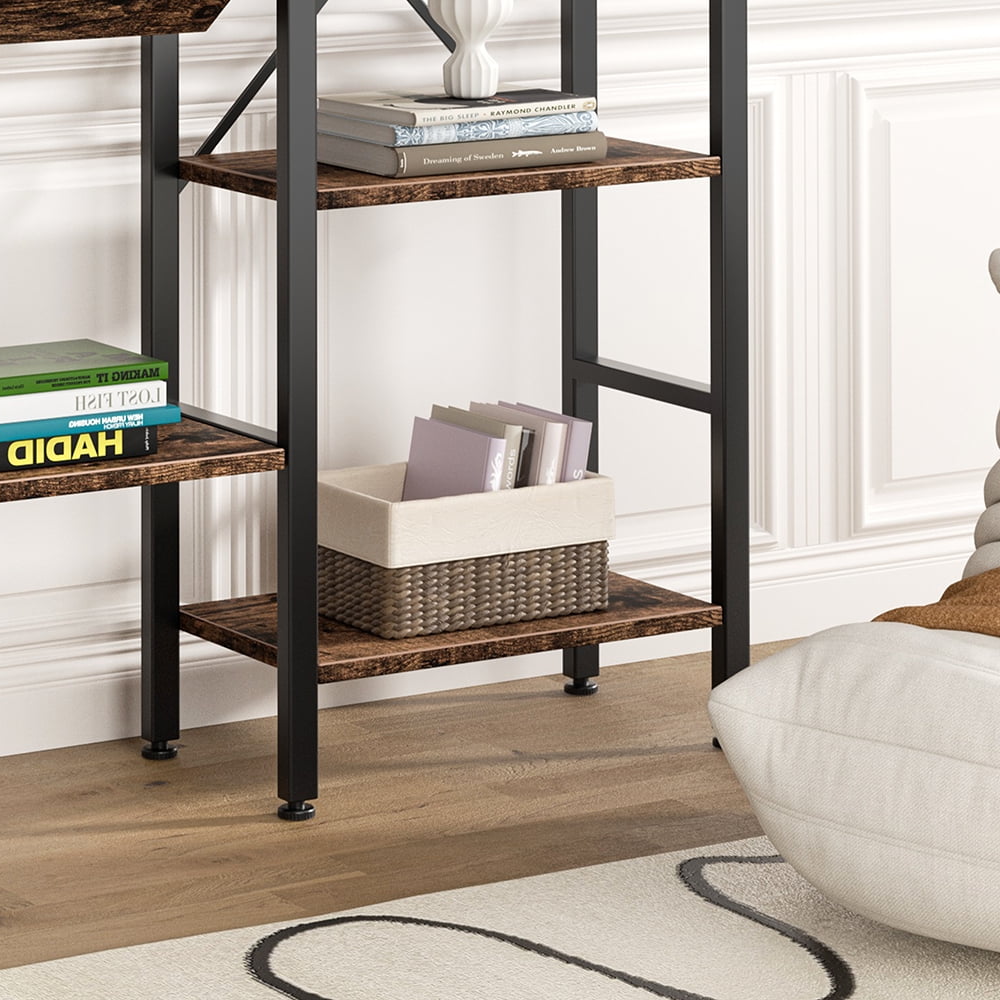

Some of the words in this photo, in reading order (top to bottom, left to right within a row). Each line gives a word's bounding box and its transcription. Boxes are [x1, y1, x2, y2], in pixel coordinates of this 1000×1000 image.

[422, 116, 438, 124] THE
[440, 114, 455, 122] BIG
[457, 112, 480, 121] SLEEP
[490, 107, 532, 118] RAYMOND
[534, 103, 577, 113] CHANDLER
[422, 154, 462, 166] Dreaming
[464, 153, 472, 162] of
[473, 150, 505, 161] Sweden
[550, 146, 576, 154] Andrew
[576, 144, 597, 152] Brown
